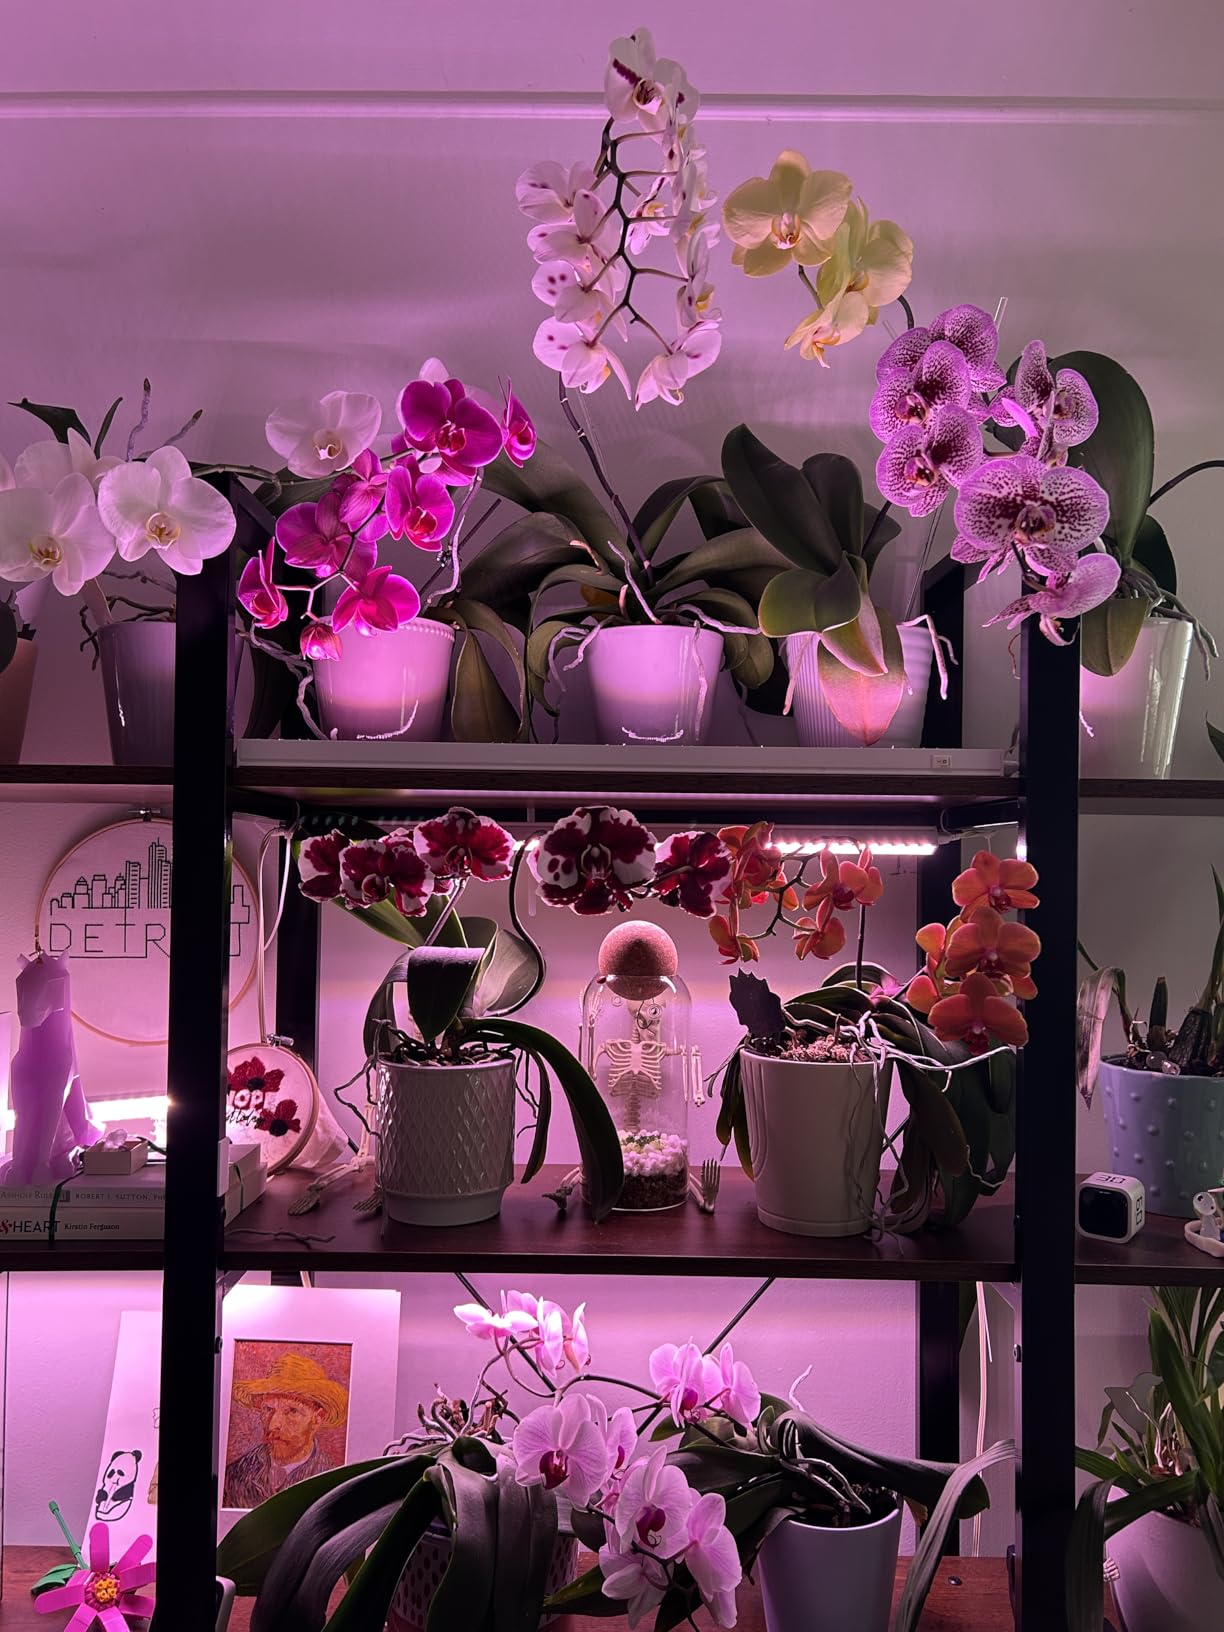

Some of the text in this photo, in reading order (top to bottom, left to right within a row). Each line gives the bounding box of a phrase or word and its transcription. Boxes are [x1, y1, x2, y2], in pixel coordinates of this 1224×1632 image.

[50, 919, 250, 957] DETRT
[1096, 1174, 1126, 1184] 30
[89, 1223, 120, 1232] Ferguson
